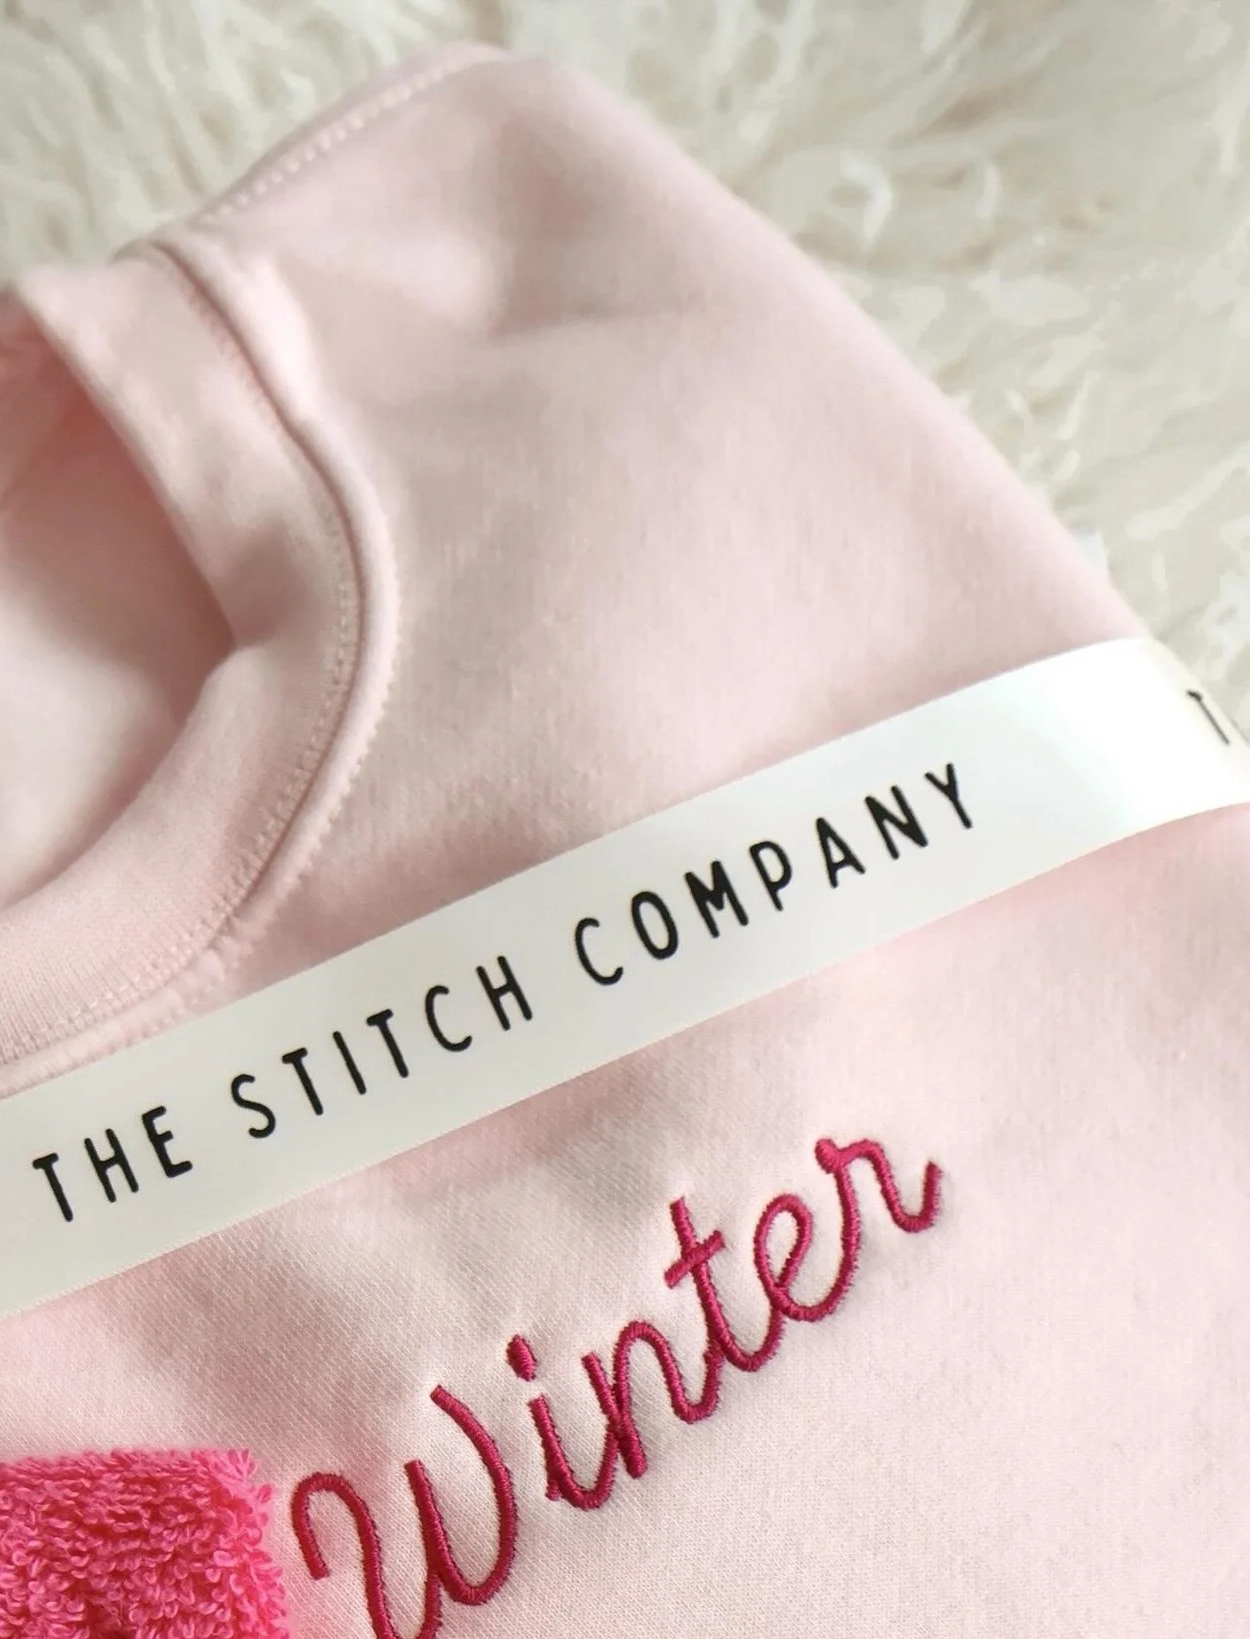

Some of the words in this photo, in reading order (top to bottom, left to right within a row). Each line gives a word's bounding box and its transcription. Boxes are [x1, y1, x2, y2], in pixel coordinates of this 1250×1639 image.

[30, 1104, 195, 1224] THE
[229, 954, 534, 1140] STITCH
[572, 761, 974, 988] COMPANY
